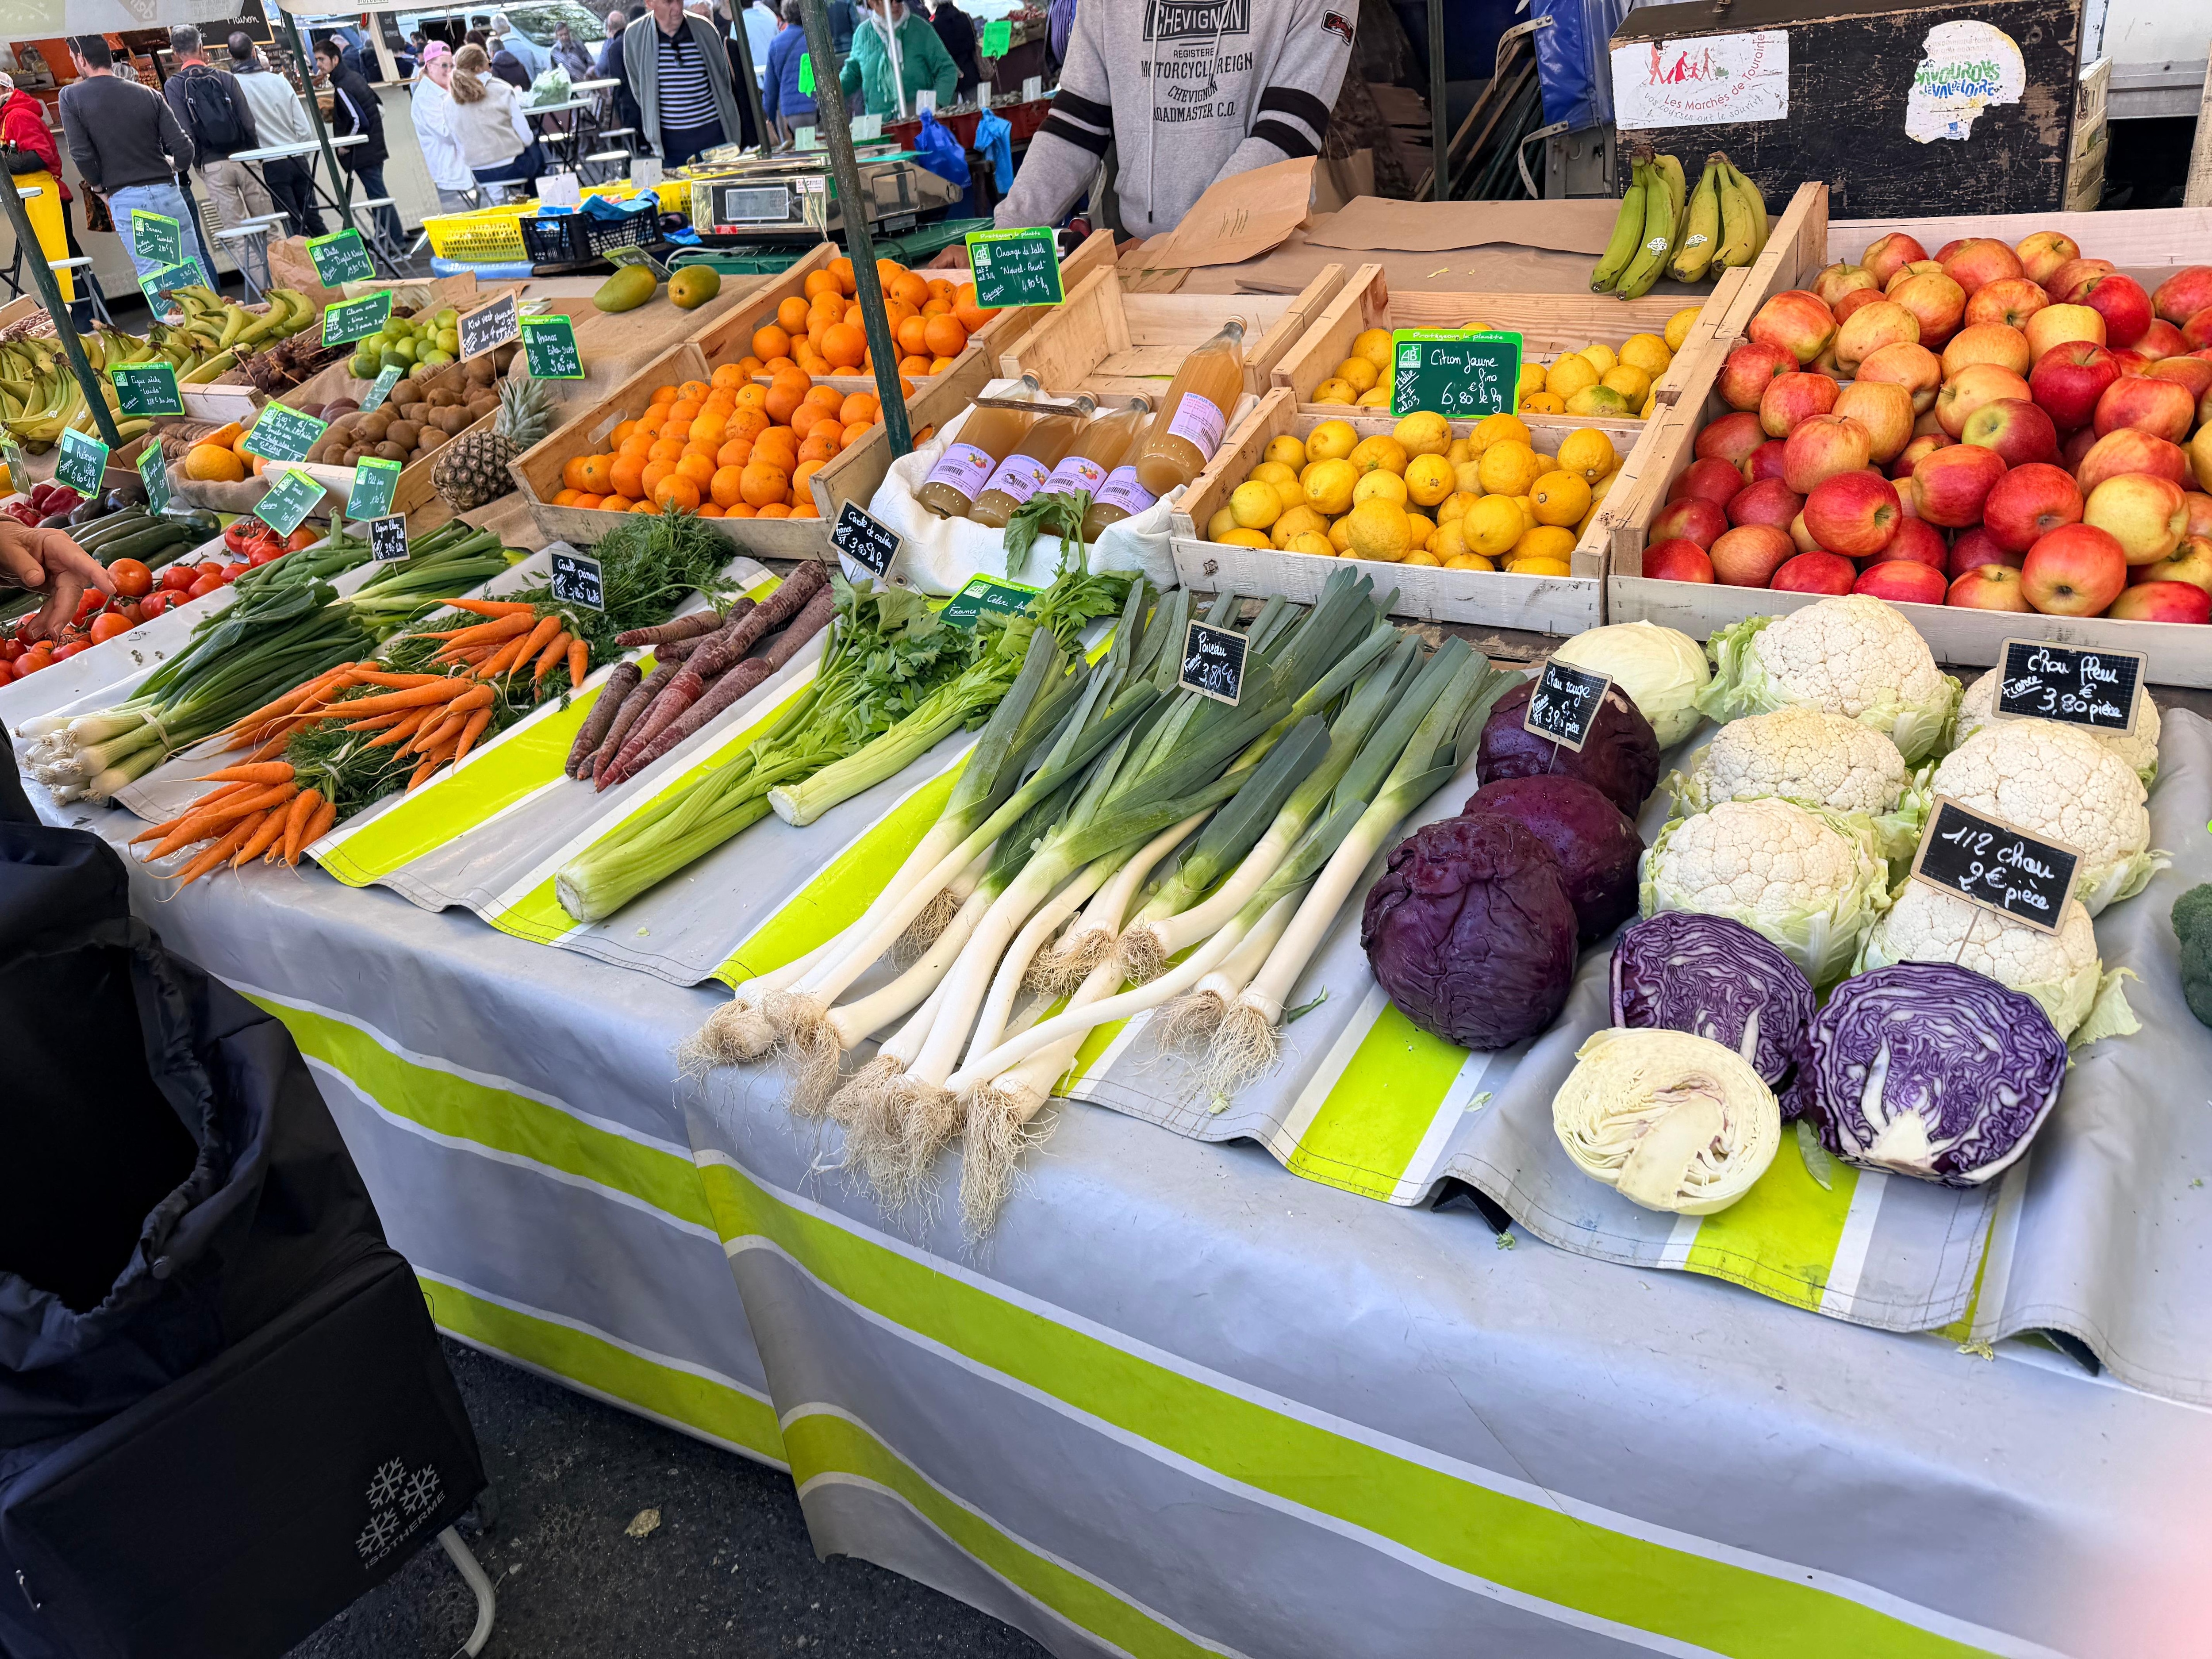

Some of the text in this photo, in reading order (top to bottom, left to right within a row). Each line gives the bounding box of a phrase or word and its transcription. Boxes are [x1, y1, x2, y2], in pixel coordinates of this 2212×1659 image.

[1157, 0, 1241, 36] CHEVIGNON
[1174, 48, 1219, 58] REGISTERE
[1217, 52, 1253, 74] REIGN
[1664, 33, 1766, 111] Les Marchés de Touraine
[1932, 83, 1953, 99] VAL
[1645, 92, 1658, 107] vos
[1659, 104, 1693, 122] courses
[1718, 111, 1725, 121] le
[976, 249, 987, 259] AB
[996, 242, 1045, 260] Orange de table
[982, 284, 1004, 301] Espagne
[468, 316, 480, 330] Kiwi
[1401, 349, 1417, 361] AB
[1431, 349, 1498, 374] Citron Jaune
[1394, 370, 1416, 390] Italie
[1478, 388, 1489, 404] le
[1490, 388, 1502, 414] kg
[867, 525, 874, 538] de
[2080, 655, 2119, 686] fleur
[1566, 681, 1590, 708] rouge
[1999, 675, 2043, 698] France
